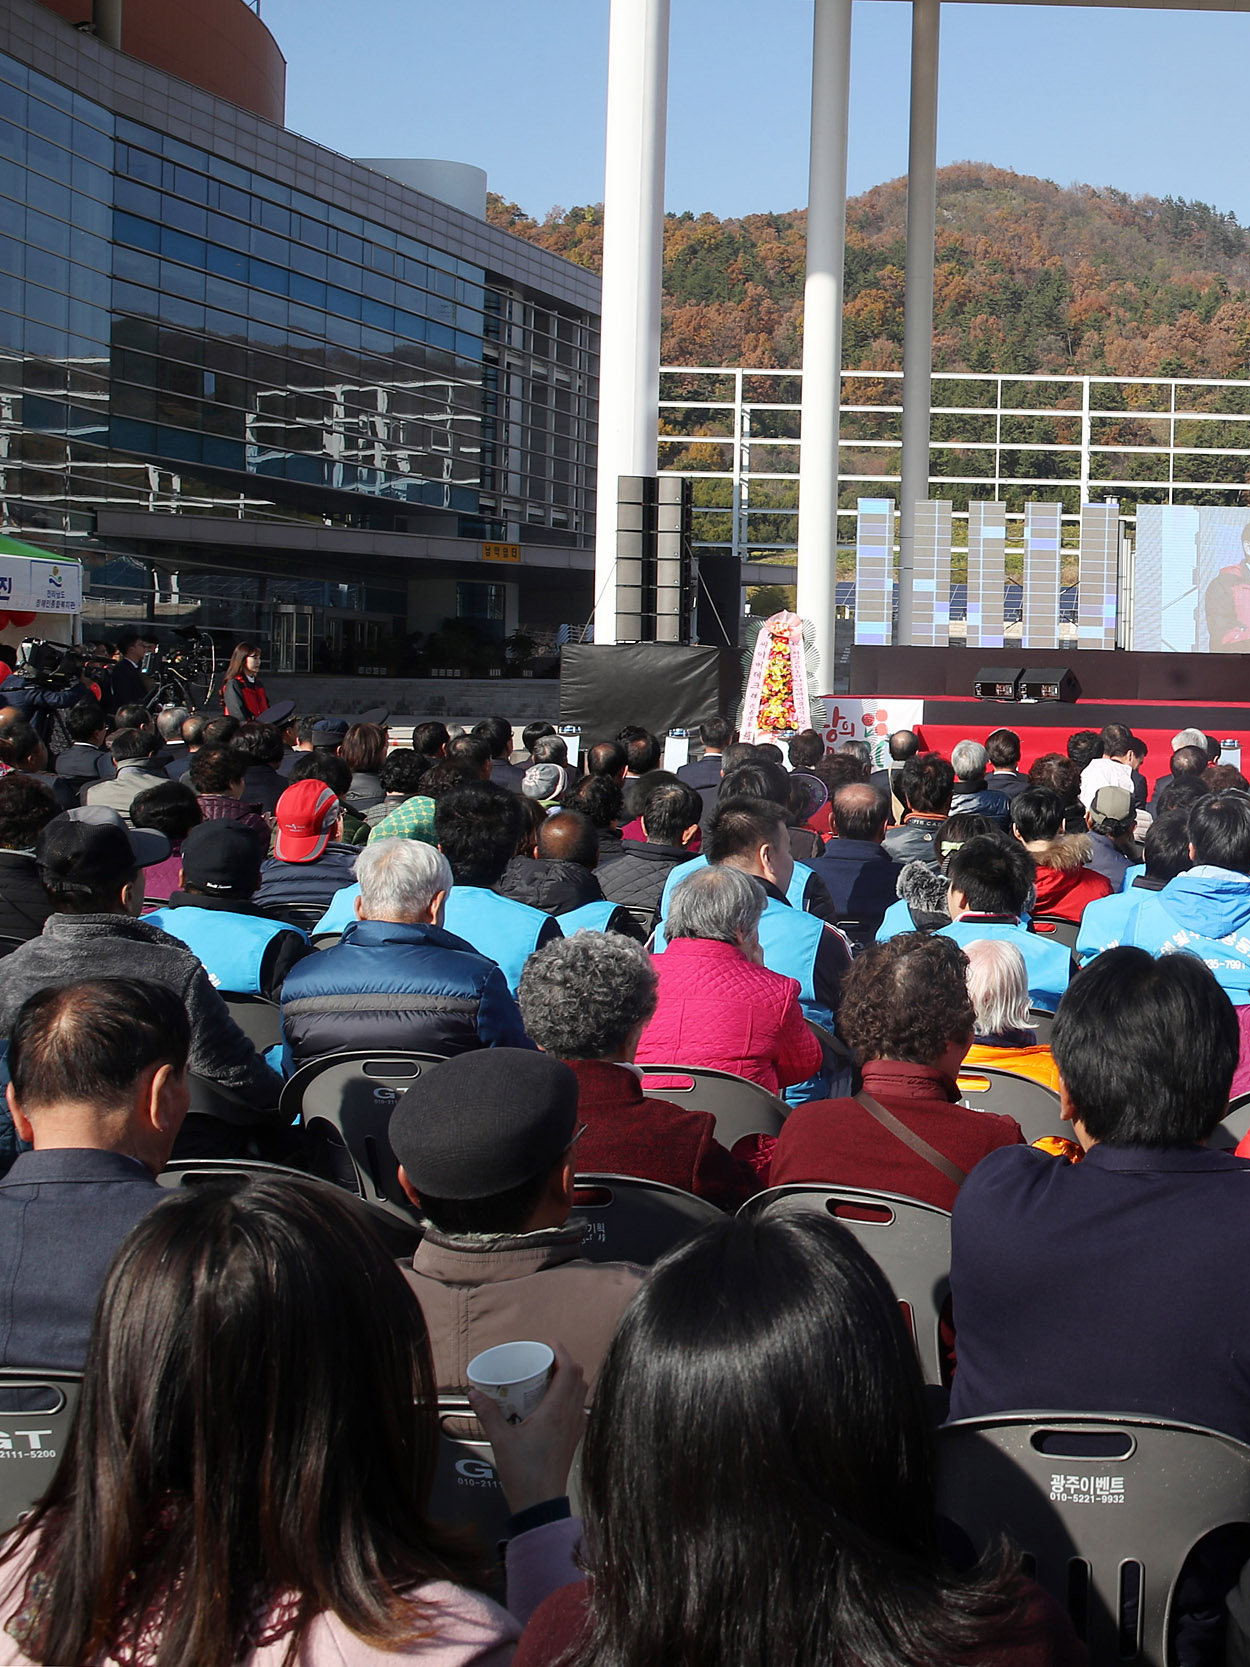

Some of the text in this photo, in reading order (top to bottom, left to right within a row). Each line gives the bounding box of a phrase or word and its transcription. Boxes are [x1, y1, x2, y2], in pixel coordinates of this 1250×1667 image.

[818, 706, 856, 742] 랑의
[1050, 1474, 1125, 1495] 광주이벤트
[1049, 1492, 1125, 1504] 010-5221-9932
